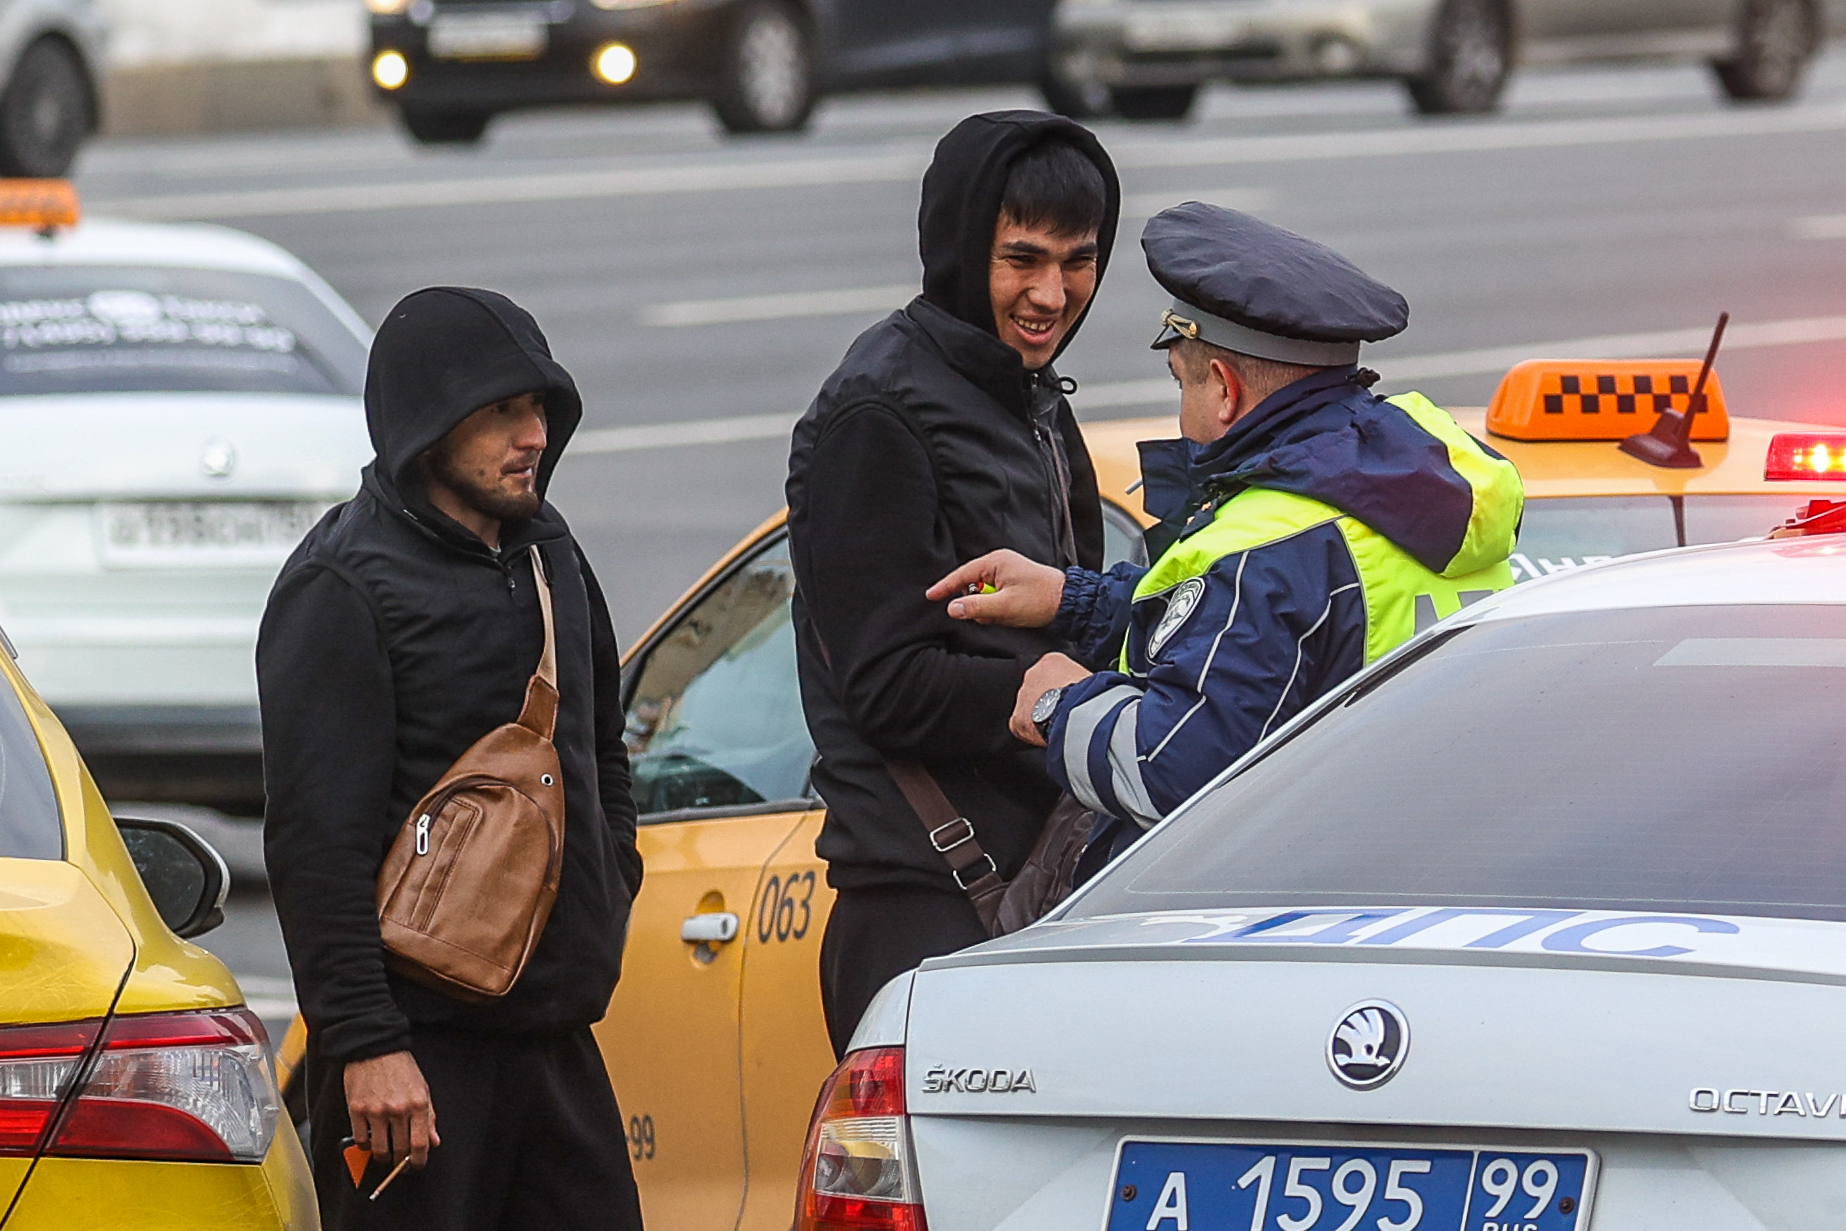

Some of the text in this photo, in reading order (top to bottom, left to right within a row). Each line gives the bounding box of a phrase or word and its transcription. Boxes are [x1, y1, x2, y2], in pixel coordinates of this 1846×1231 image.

[758, 870, 815, 943] 063
[1182, 908, 1740, 957] ДПС
[921, 1063, 1037, 1094] ŠKODA
[1236, 1155, 1432, 1231] 1595
[1482, 1157, 1559, 1219] 99
